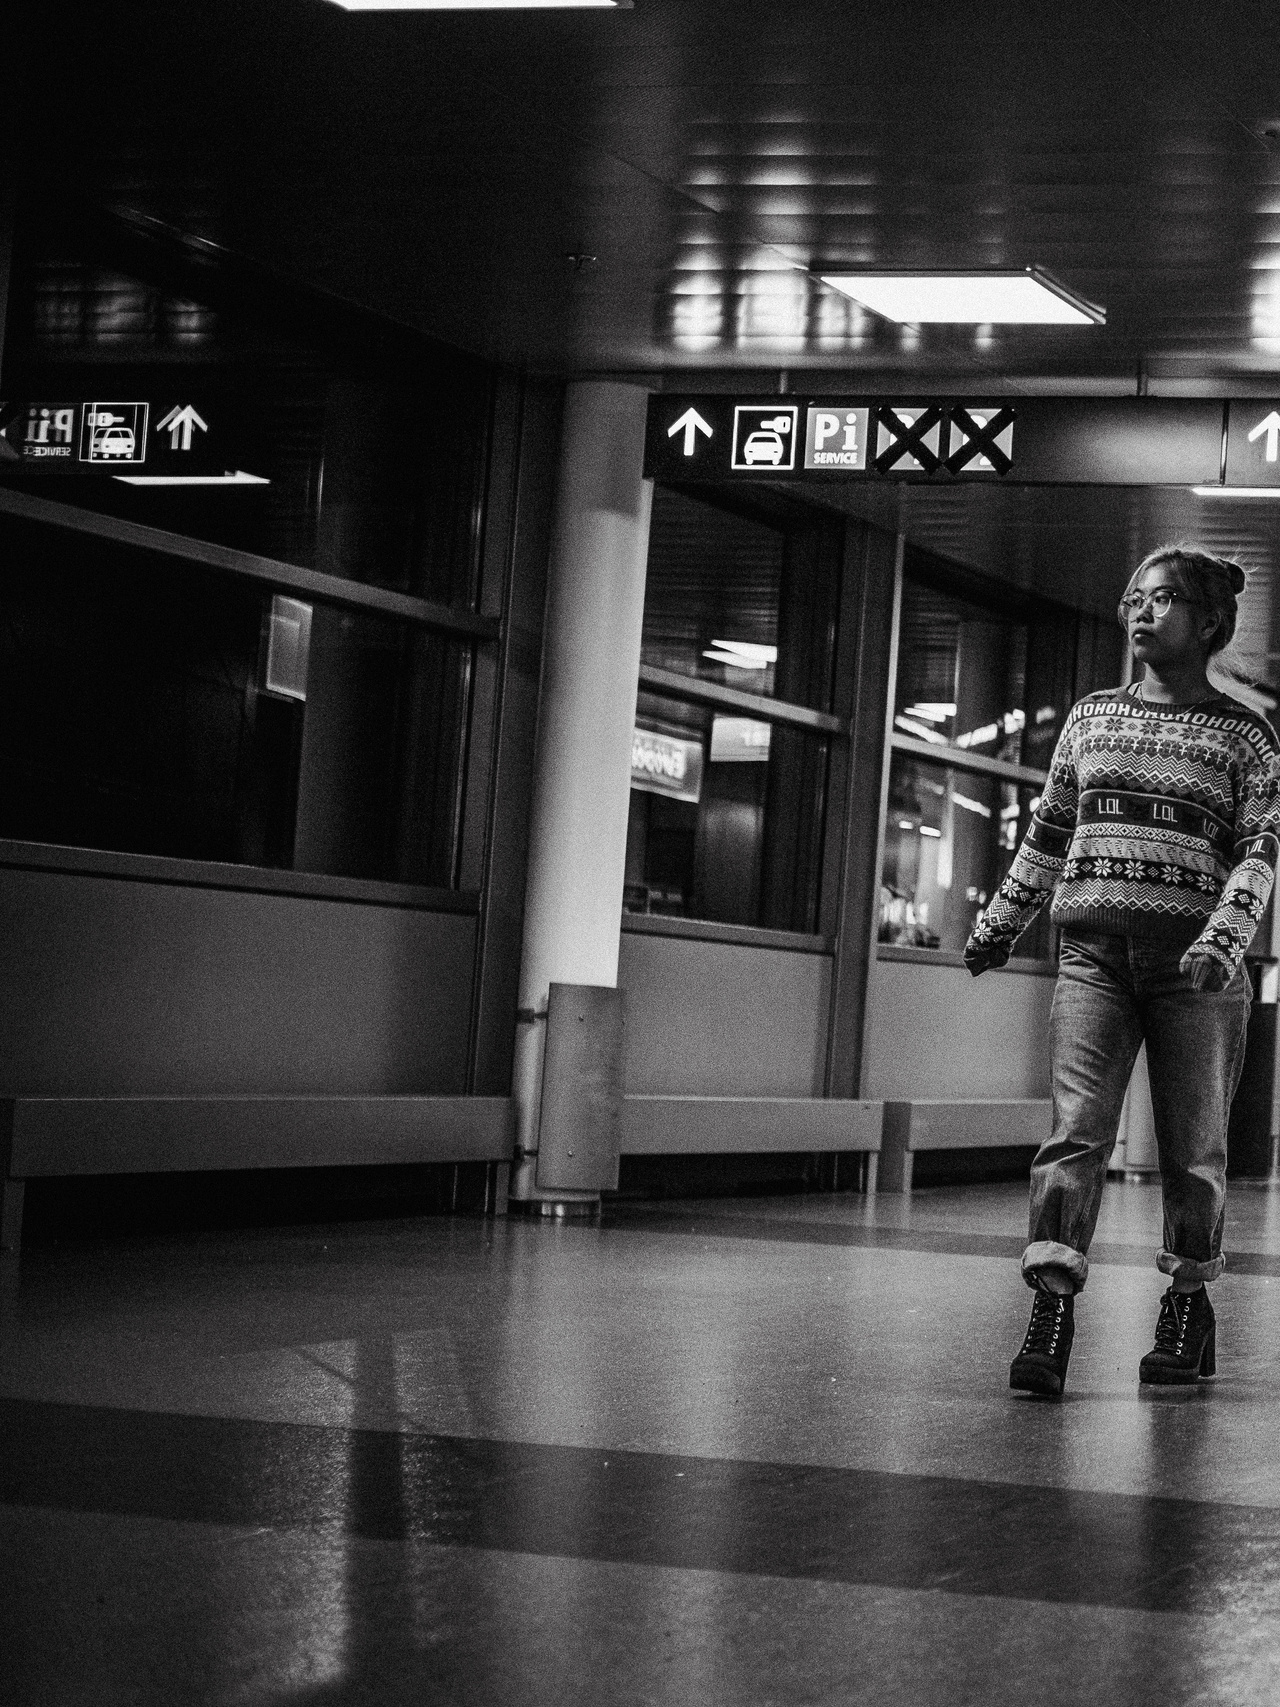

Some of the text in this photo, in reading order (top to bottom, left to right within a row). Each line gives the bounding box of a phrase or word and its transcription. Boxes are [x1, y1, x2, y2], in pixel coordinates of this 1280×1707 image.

[813, 451, 858, 465] SERVICE
[1097, 797, 1220, 841] LOL LOL LOL
[1245, 838, 1267, 859] LOL
